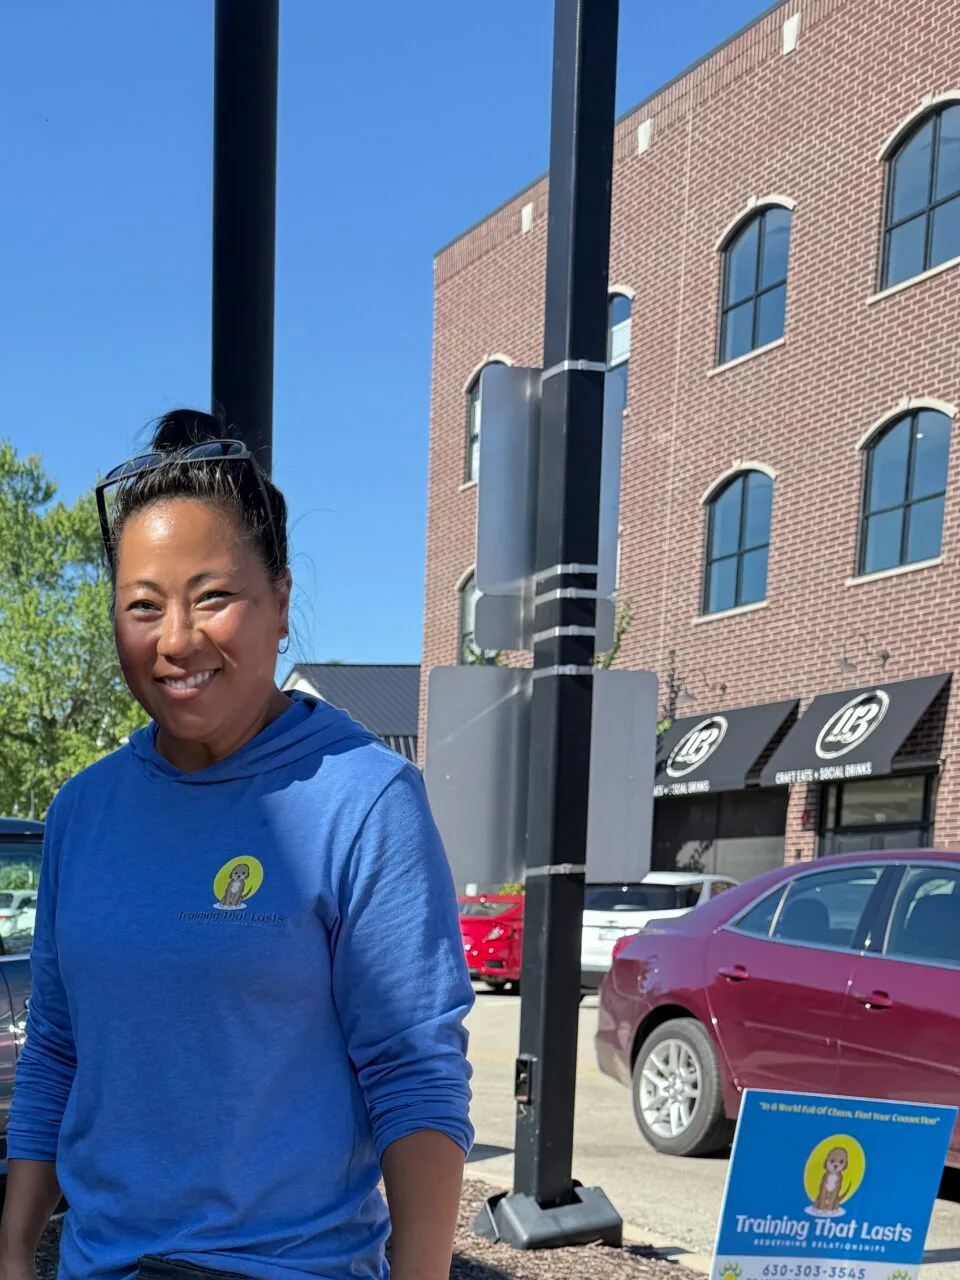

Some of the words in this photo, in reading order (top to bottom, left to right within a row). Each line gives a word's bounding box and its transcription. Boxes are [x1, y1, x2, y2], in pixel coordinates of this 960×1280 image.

[820, 765, 844, 780] SOCIAL
[845, 762, 872, 778] DRINKS
[178, 911, 220, 922] Training
[250, 912, 284, 923] Lasts
[735, 1215, 810, 1240] Training
[814, 1217, 858, 1239] That
[861, 1222, 913, 1243] Lasts
[753, 1238, 808, 1248] REDEFINING
[812, 1241, 886, 1253] RELATIONSHIPS
[762, 1264, 866, 1280] 630-303-3545
